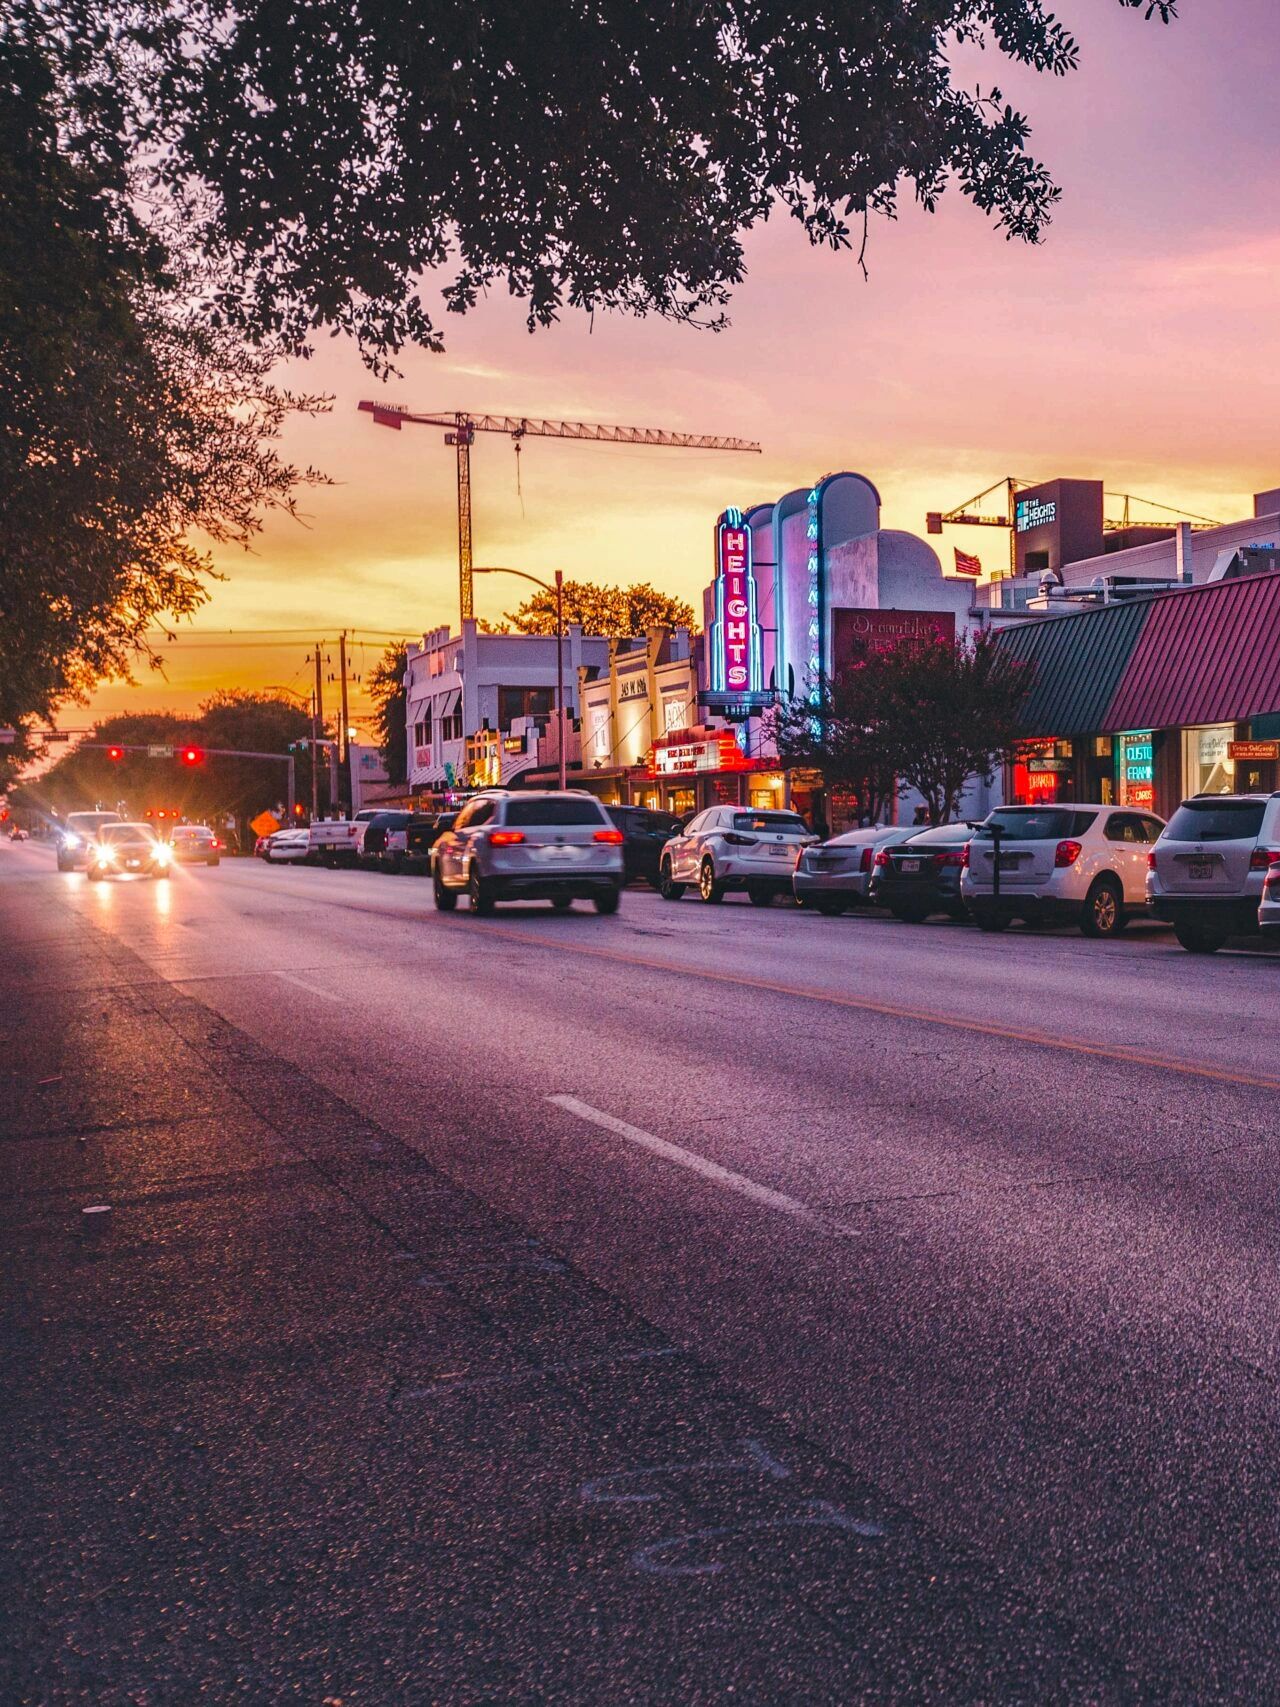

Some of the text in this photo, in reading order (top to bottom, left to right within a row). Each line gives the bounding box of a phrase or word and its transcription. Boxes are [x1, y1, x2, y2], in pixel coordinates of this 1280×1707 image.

[1029, 498, 1039, 508] THE
[1029, 502, 1056, 521] HEIGHTS
[727, 532, 748, 685] HEIGHTS
[1127, 746, 1152, 761] CUSTO
